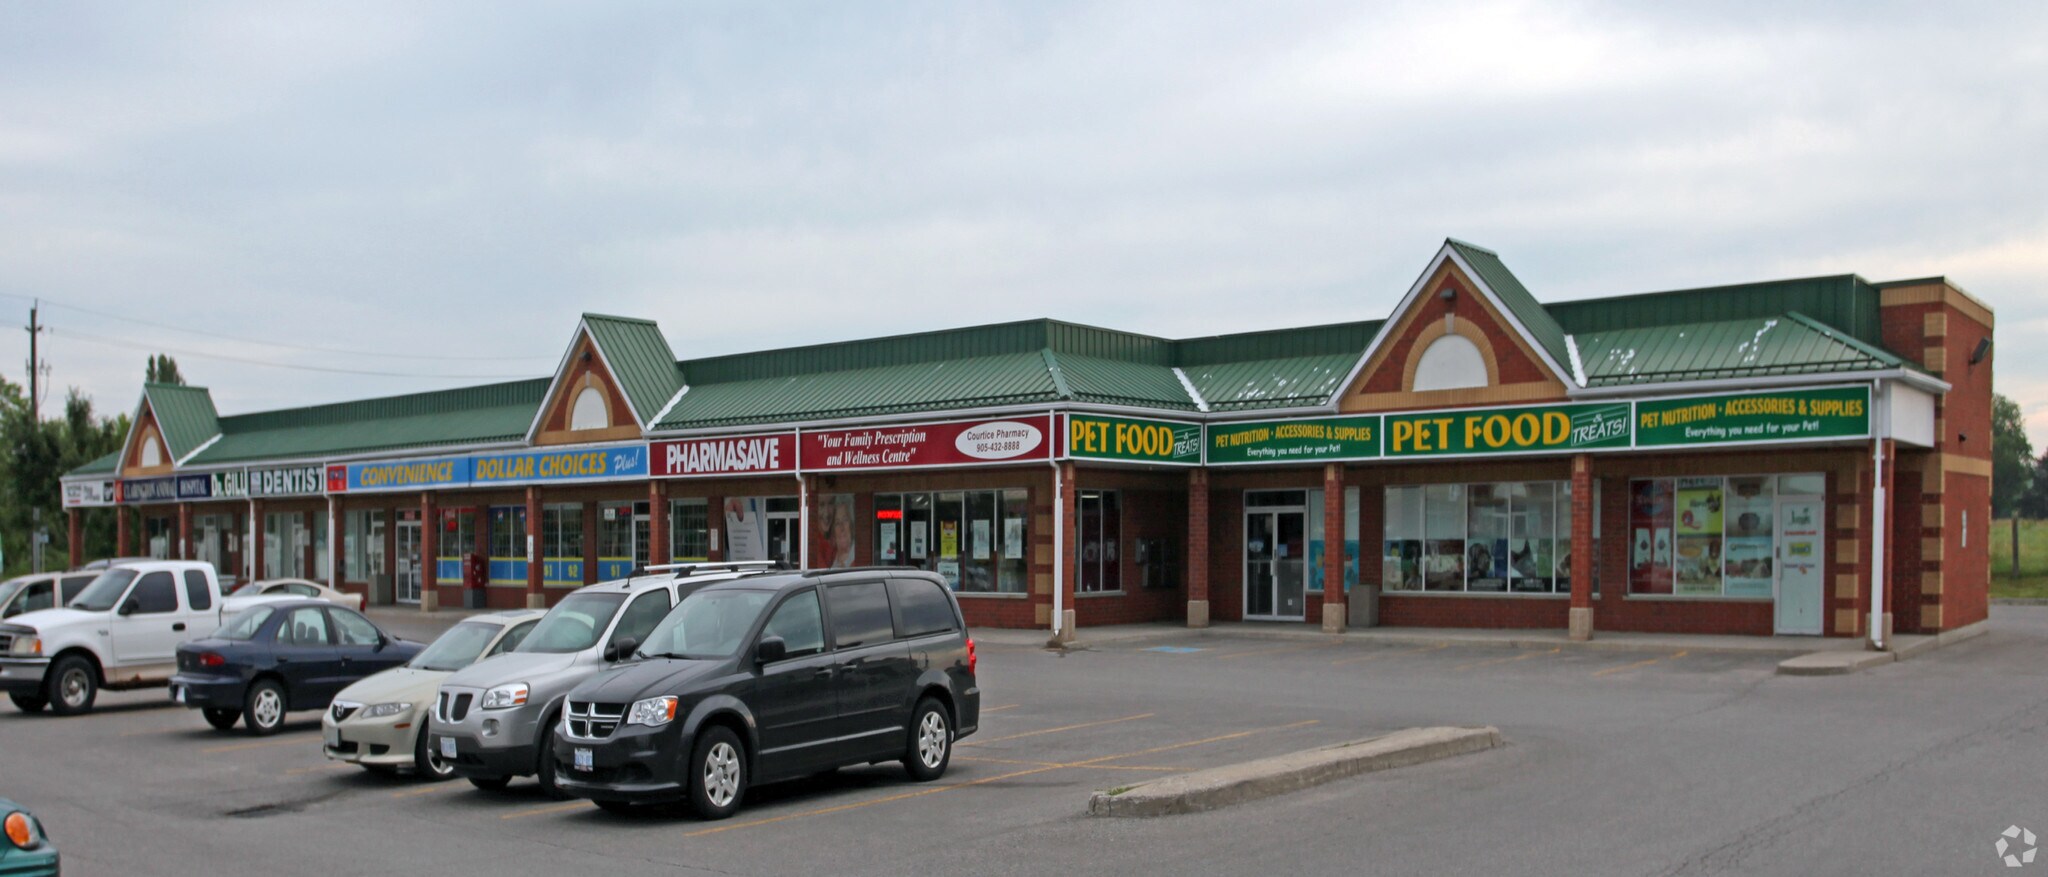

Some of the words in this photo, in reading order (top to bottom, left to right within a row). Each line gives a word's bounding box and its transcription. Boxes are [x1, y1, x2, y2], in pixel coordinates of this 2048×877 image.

[1593, 413, 1602, 423] &
[1640, 413, 1659, 428] PET
[1662, 403, 1716, 426] NUTRITION
[1725, 398, 1796, 416] ACCESSORIES
[1798, 399, 1807, 415] &
[1809, 399, 1863, 417] SUPPLIES
[818, 434, 843, 448] "Your
[844, 431, 873, 449] Family
[874, 428, 926, 447] Prescription
[967, 431, 995, 441] Courtice
[996, 429, 1030, 439] Pharmacy
[1071, 419, 1110, 453] PET
[1116, 423, 1174, 456] FOOD
[1183, 432, 1190, 440] &
[1216, 434, 1228, 448] PET
[1230, 428, 1269, 446] NUTRITION
[1275, 425, 1325, 439] ACCESSORIES
[1326, 426, 1333, 439] &
[1334, 426, 1371, 442] SUPPLIES
[1393, 417, 1454, 451] PET
[1464, 411, 1571, 449] FOOD
[1572, 416, 1627, 444] TREATS!
[1685, 425, 1726, 439] Everything
[1728, 425, 1742, 437] you
[1744, 423, 1764, 434] need
[1766, 423, 1778, 434] for
[1782, 423, 1800, 435] your
[1802, 420, 1819, 432] Pet!
[666, 438, 779, 474] PHARMASAVE
[826, 451, 843, 466] and
[844, 450, 880, 465] Wellness
[882, 447, 917, 464] Centre"
[976, 441, 1020, 453] 905-432-8888
[1174, 437, 1200, 455] TREATS!
[1247, 447, 1276, 458] Everything
[1277, 447, 1287, 457] you
[1288, 445, 1302, 455] need
[1303, 444, 1312, 454] for
[1315, 445, 1328, 455] your
[1329, 443, 1341, 453] Pet!
[361, 461, 454, 486] CONVENIENCE
[476, 456, 534, 480] DOLLAR
[539, 452, 607, 476] CHOICES
[613, 448, 640, 475] Plus!
[263, 467, 324, 494] DENTIST
